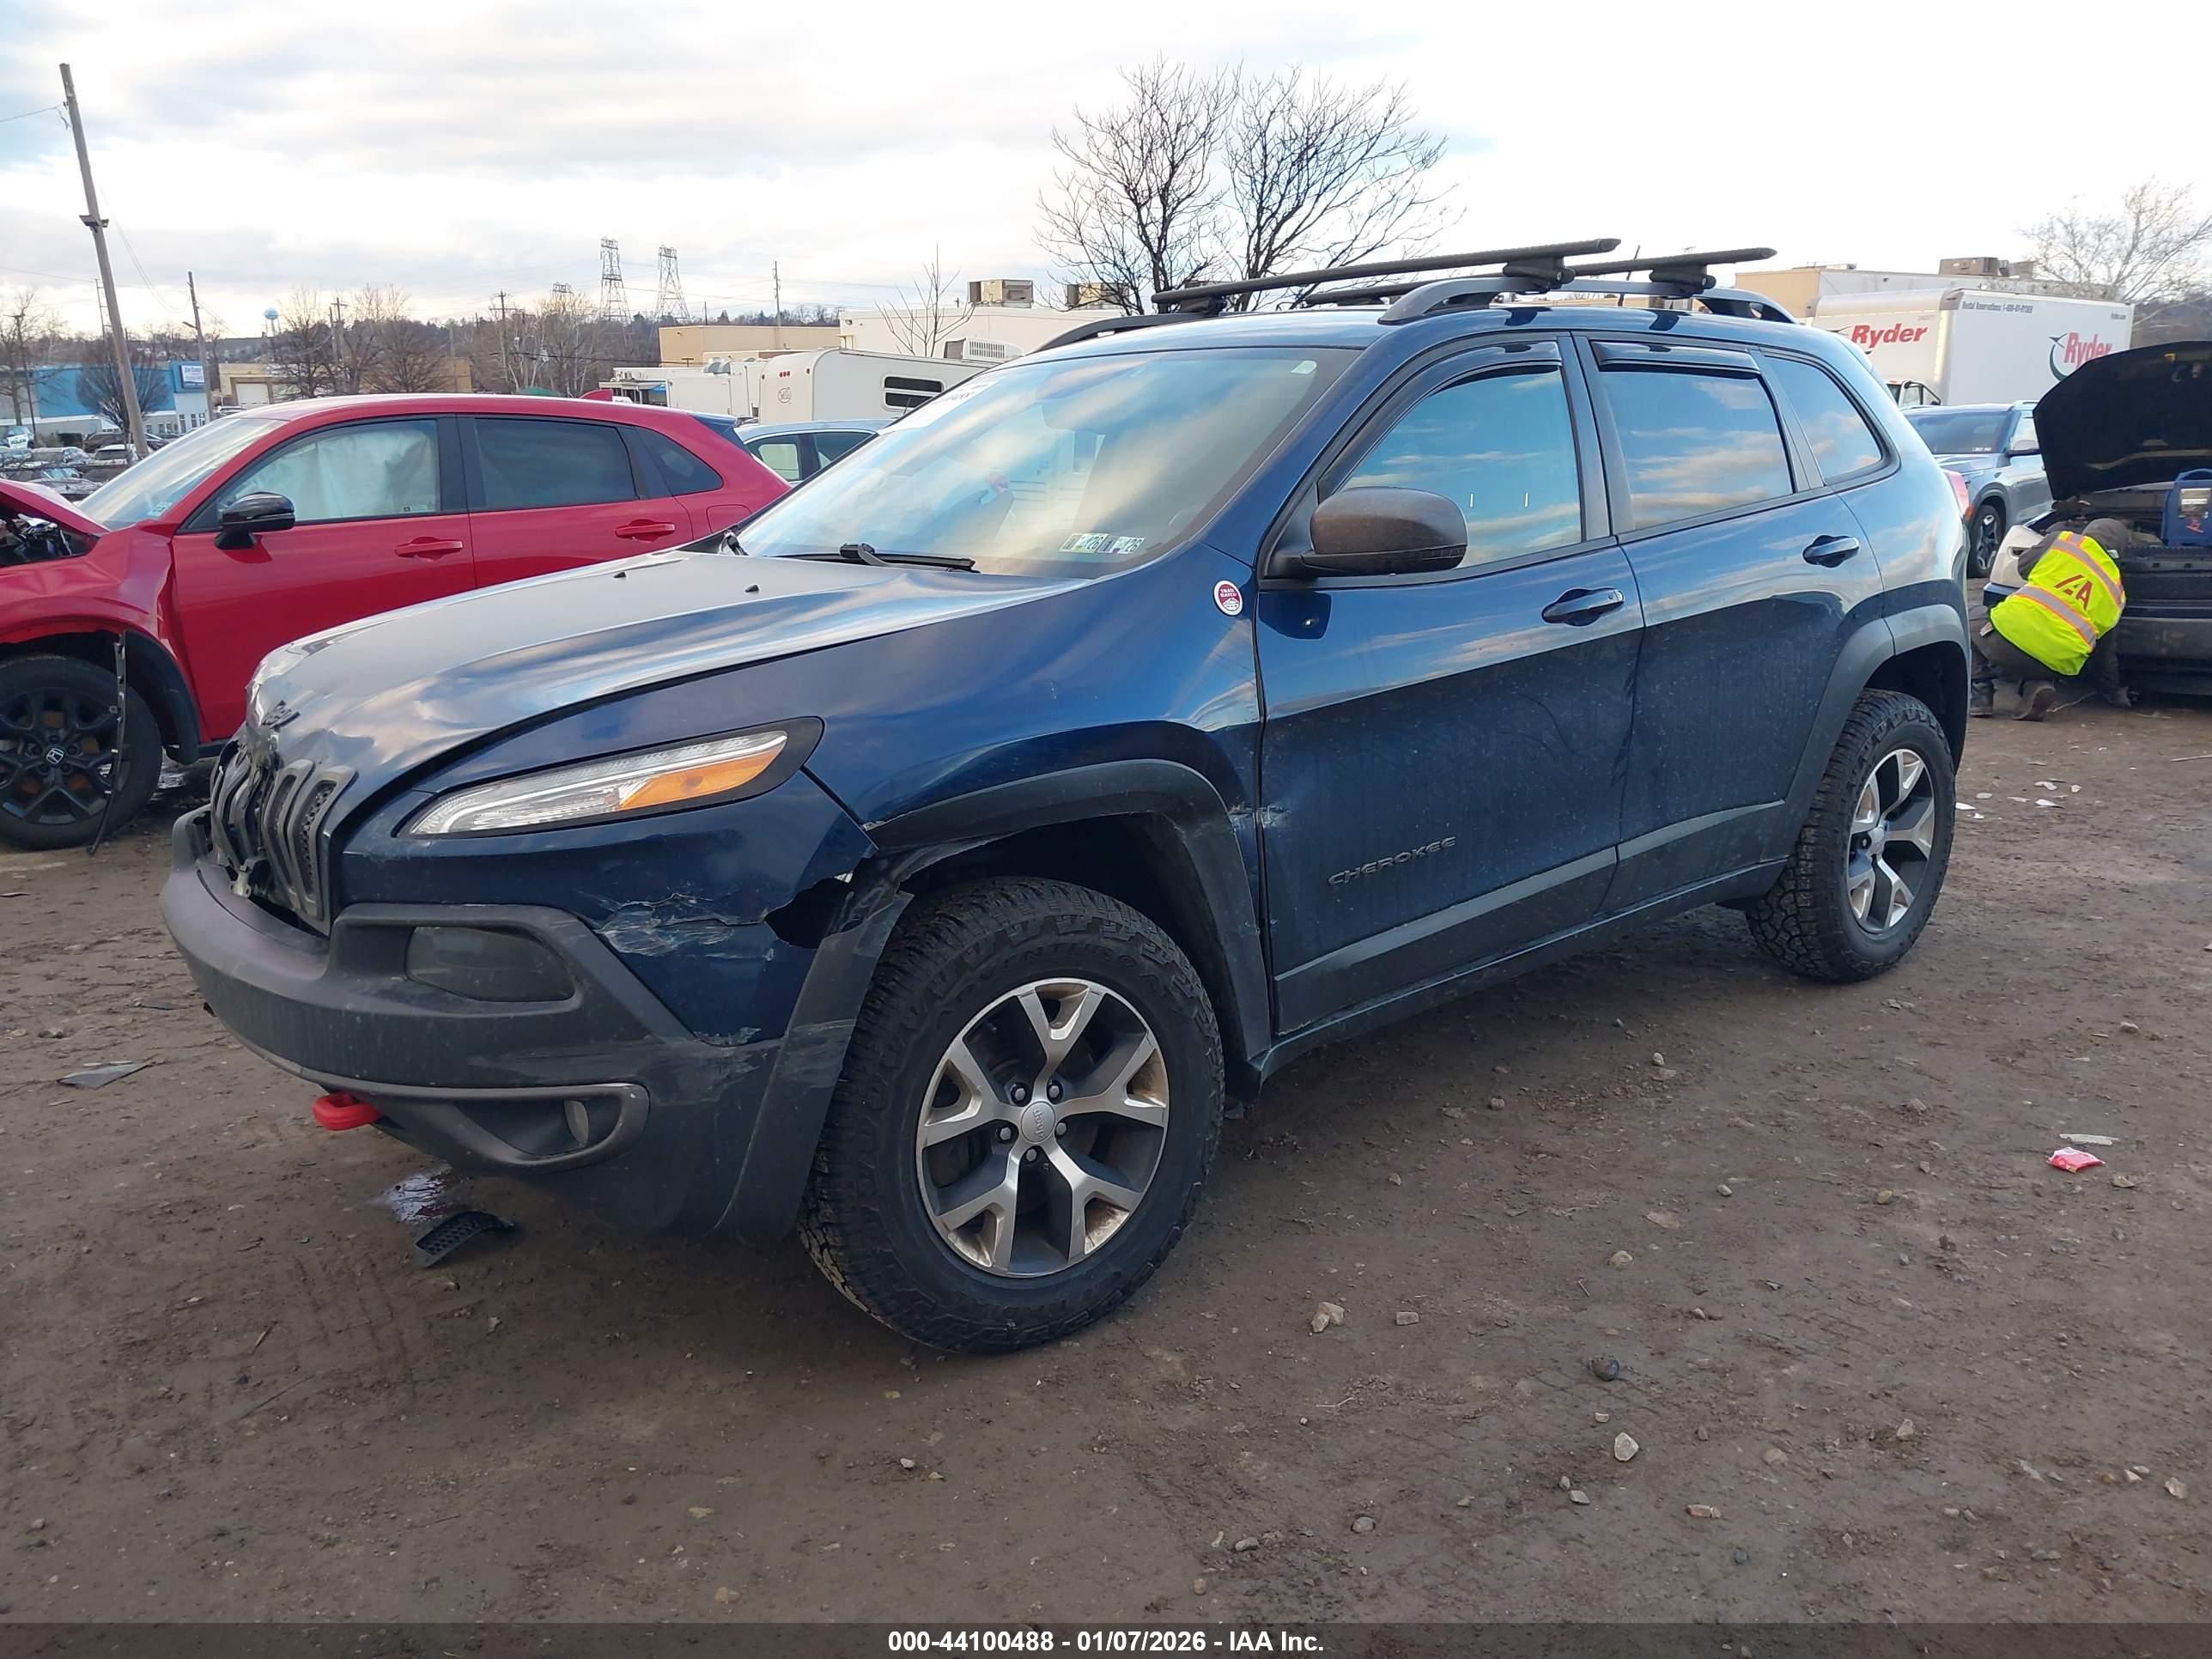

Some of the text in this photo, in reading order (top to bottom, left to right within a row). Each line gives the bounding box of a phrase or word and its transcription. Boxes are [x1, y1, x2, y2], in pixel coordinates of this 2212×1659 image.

[1850, 323, 1929, 349] Ryder
[2063, 331, 2112, 369] Ryder
[1328, 836, 1456, 885] CHEROKEE
[1033, 1107, 1045, 1138] Jeep
